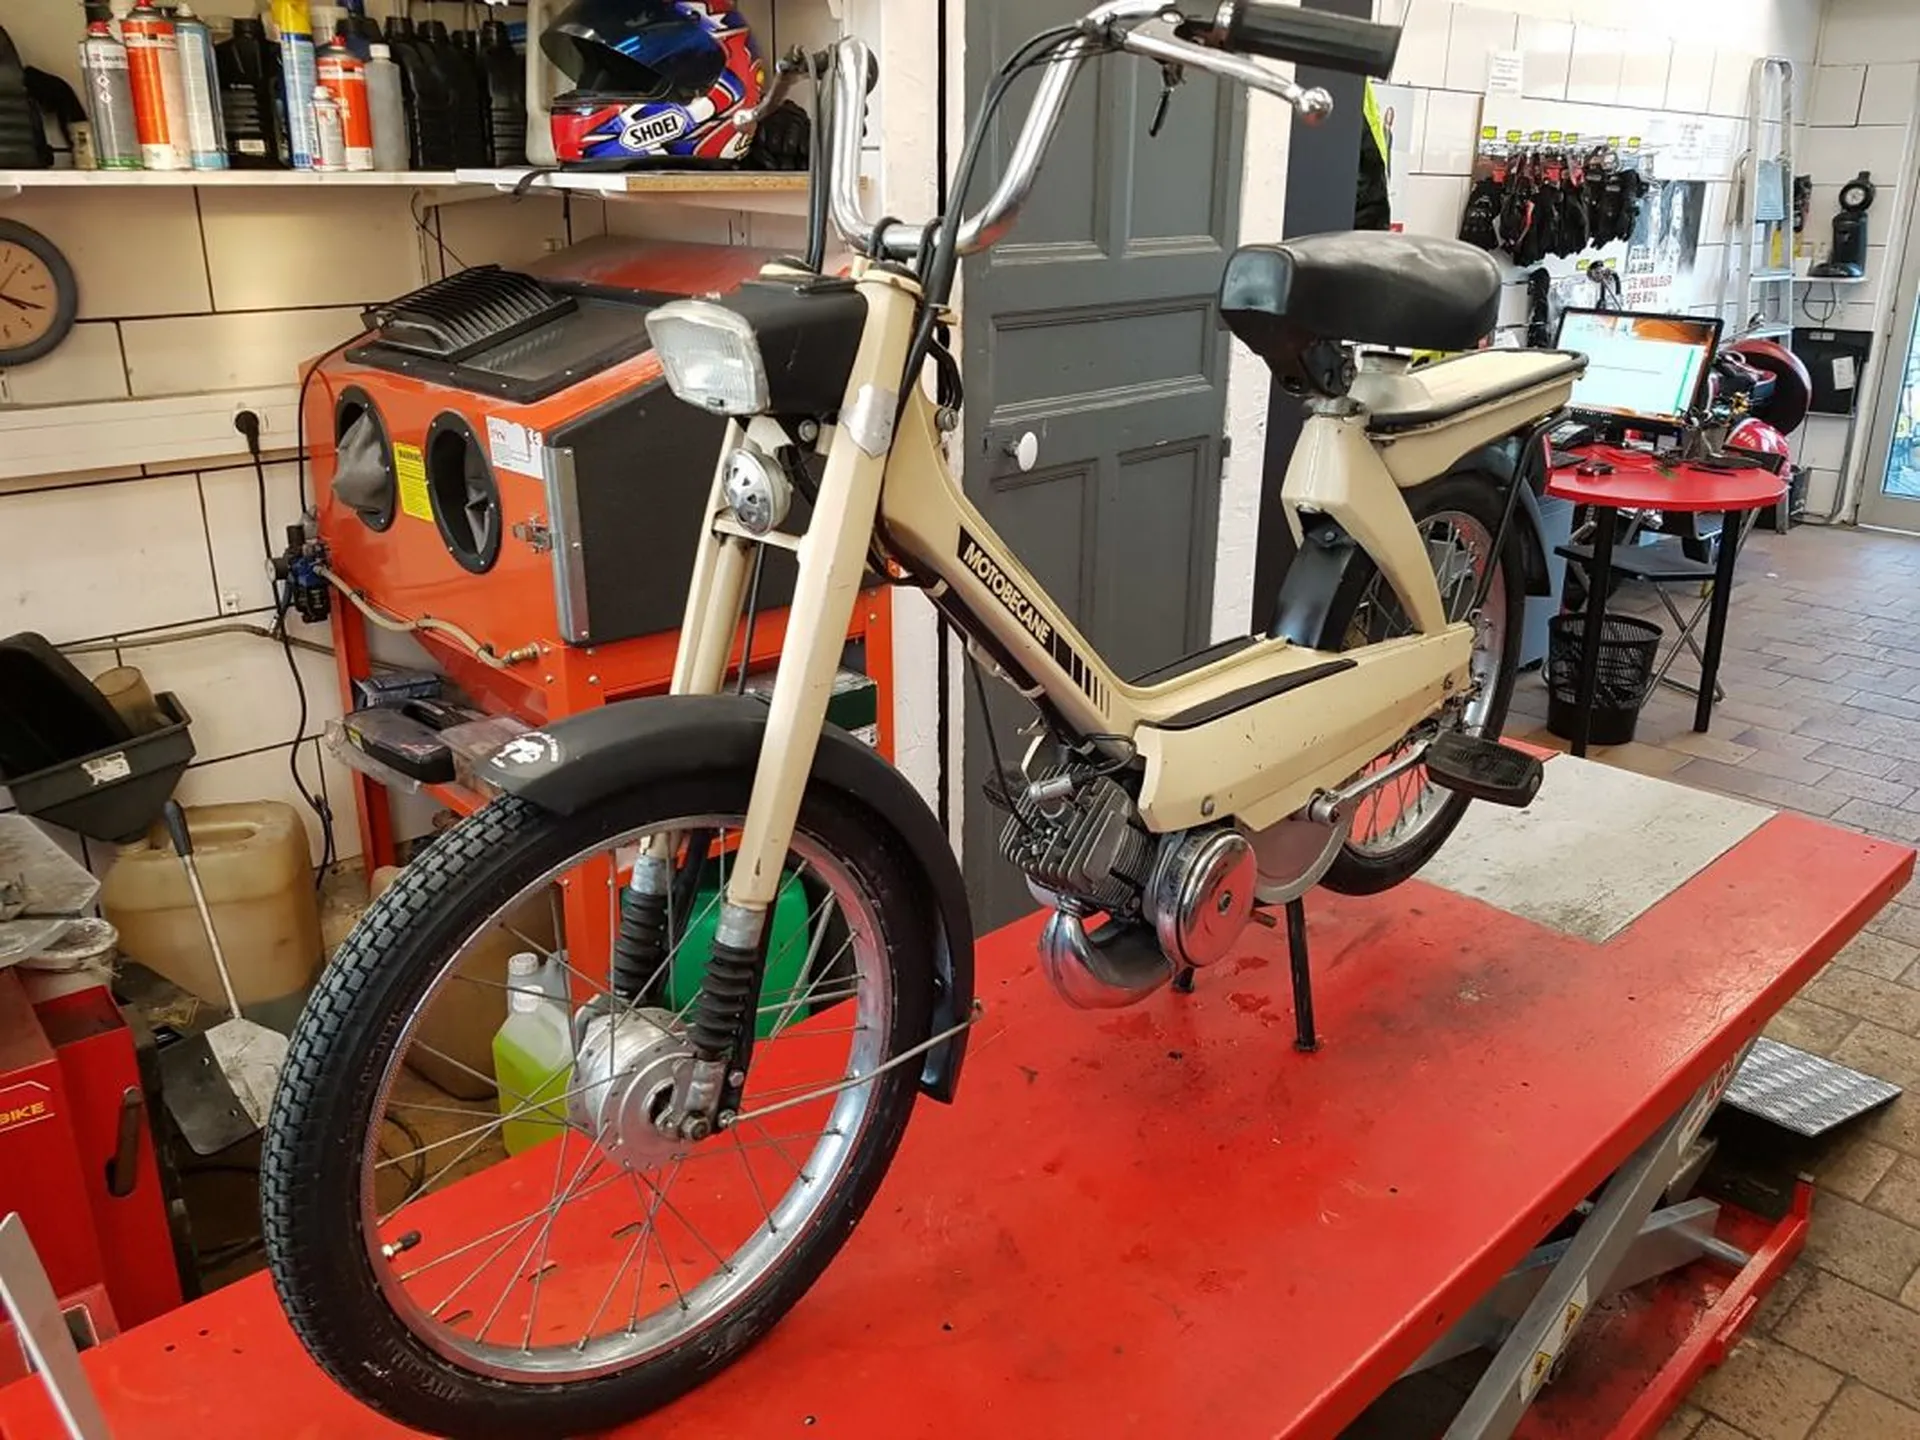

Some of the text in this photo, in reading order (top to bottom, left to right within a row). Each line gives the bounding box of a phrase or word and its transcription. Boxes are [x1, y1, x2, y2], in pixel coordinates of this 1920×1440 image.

[630, 115, 678, 144] SHOEI
[963, 542, 1051, 645] MOTOBECANE
[0, 1101, 46, 1125] BIKE
